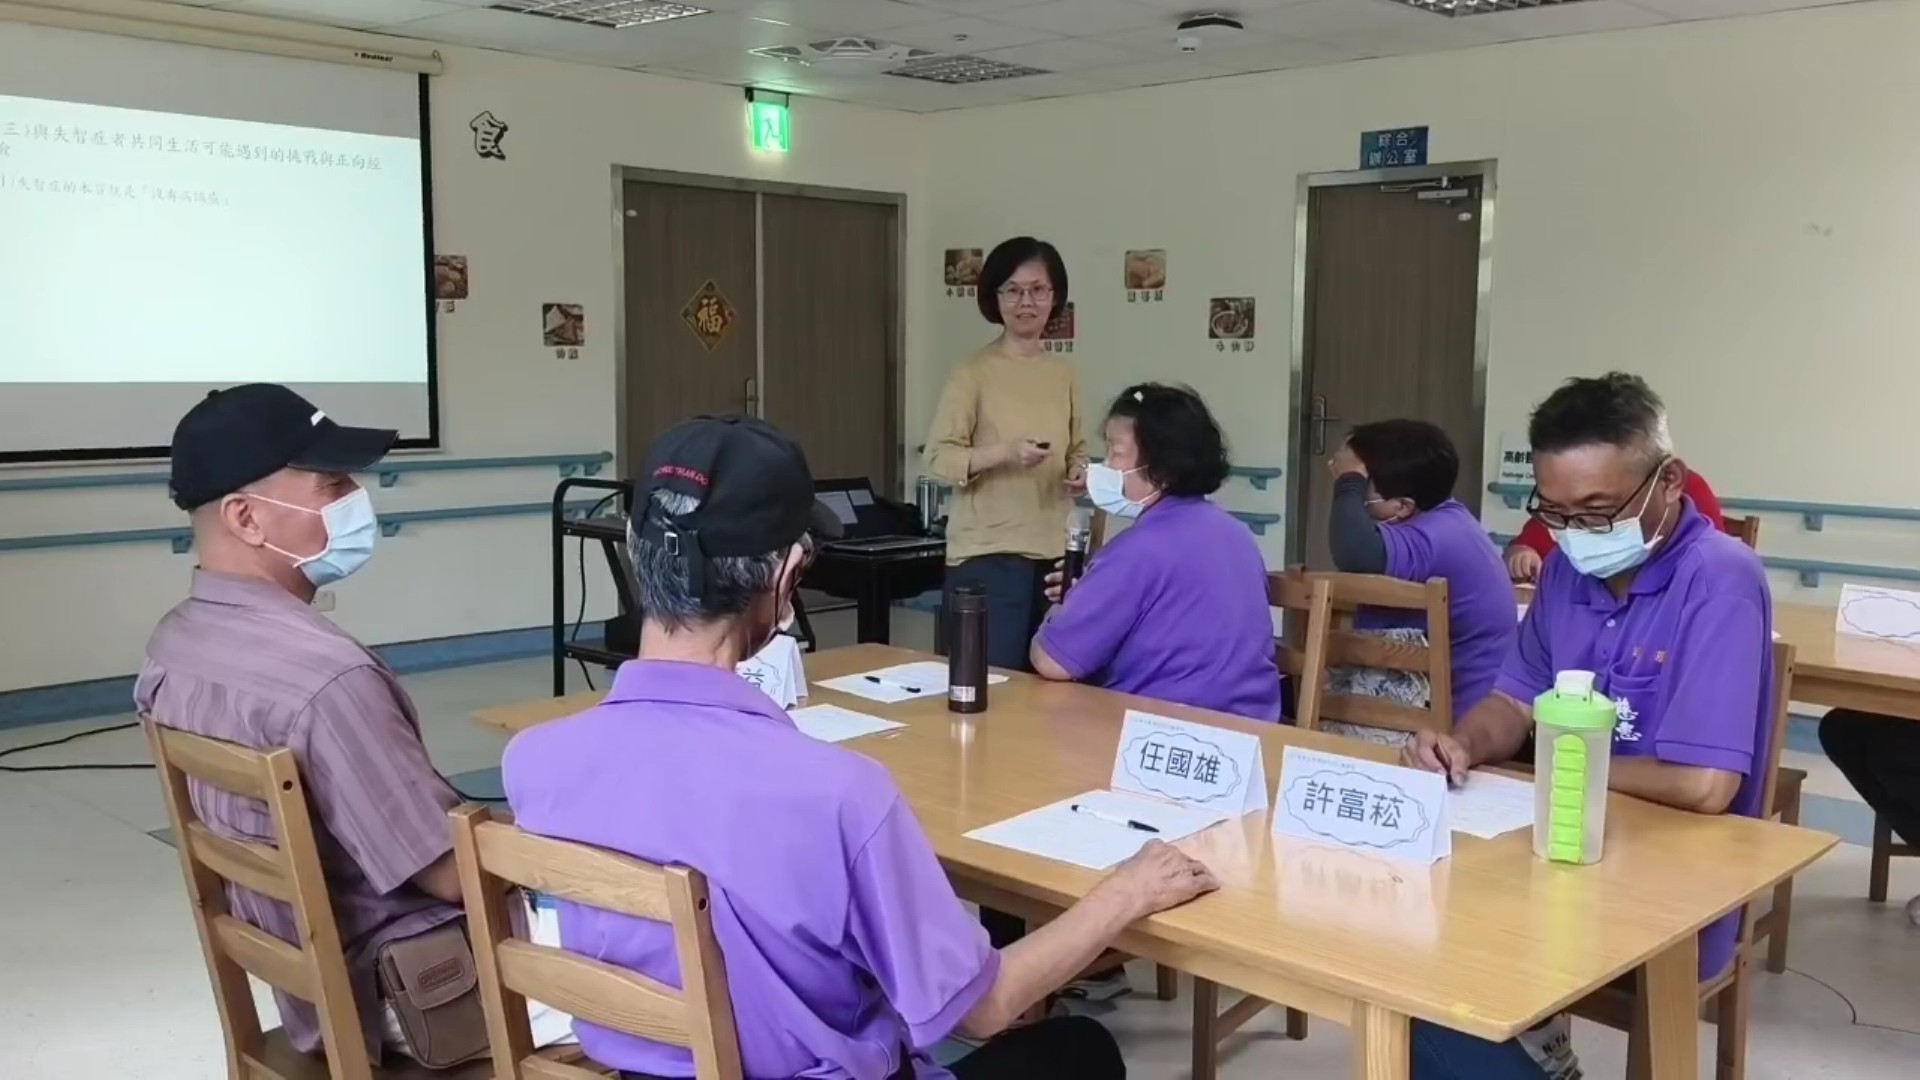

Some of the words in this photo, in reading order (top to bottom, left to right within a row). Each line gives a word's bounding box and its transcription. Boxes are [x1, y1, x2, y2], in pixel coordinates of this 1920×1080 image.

[469, 110, 509, 161] 食
[1368, 148, 1418, 167] 辦公室
[697, 297, 723, 333] 福
[1140, 740, 1221, 785] 任國雄
[1302, 779, 1404, 830] 許富菘
